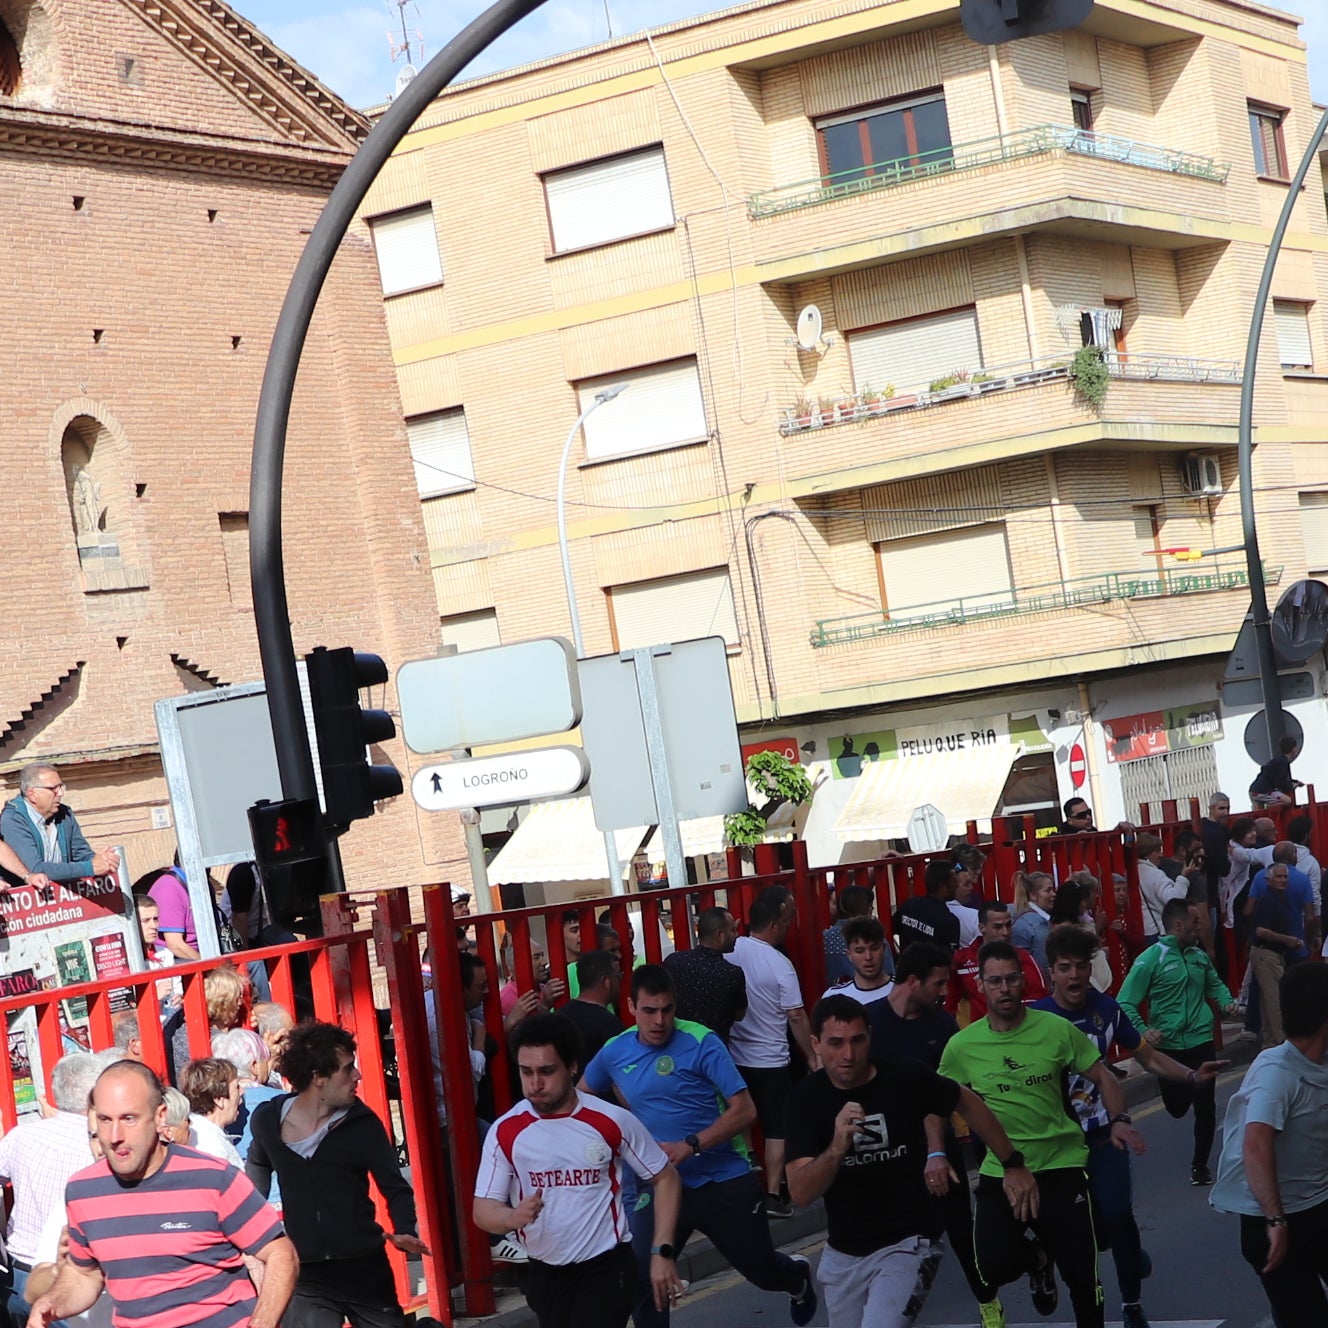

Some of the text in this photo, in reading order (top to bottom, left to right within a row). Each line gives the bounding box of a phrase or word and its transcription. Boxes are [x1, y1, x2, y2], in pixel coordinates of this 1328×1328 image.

[462, 767, 529, 789] LOGROÑO
[34, 884, 57, 908] DE
[59, 873, 116, 903] ALFARO
[25, 905, 84, 929] ciudadana
[996, 1083, 1011, 1094] Tu
[843, 1144, 908, 1167] alomon
[527, 1168, 602, 1189] BETEARTE
